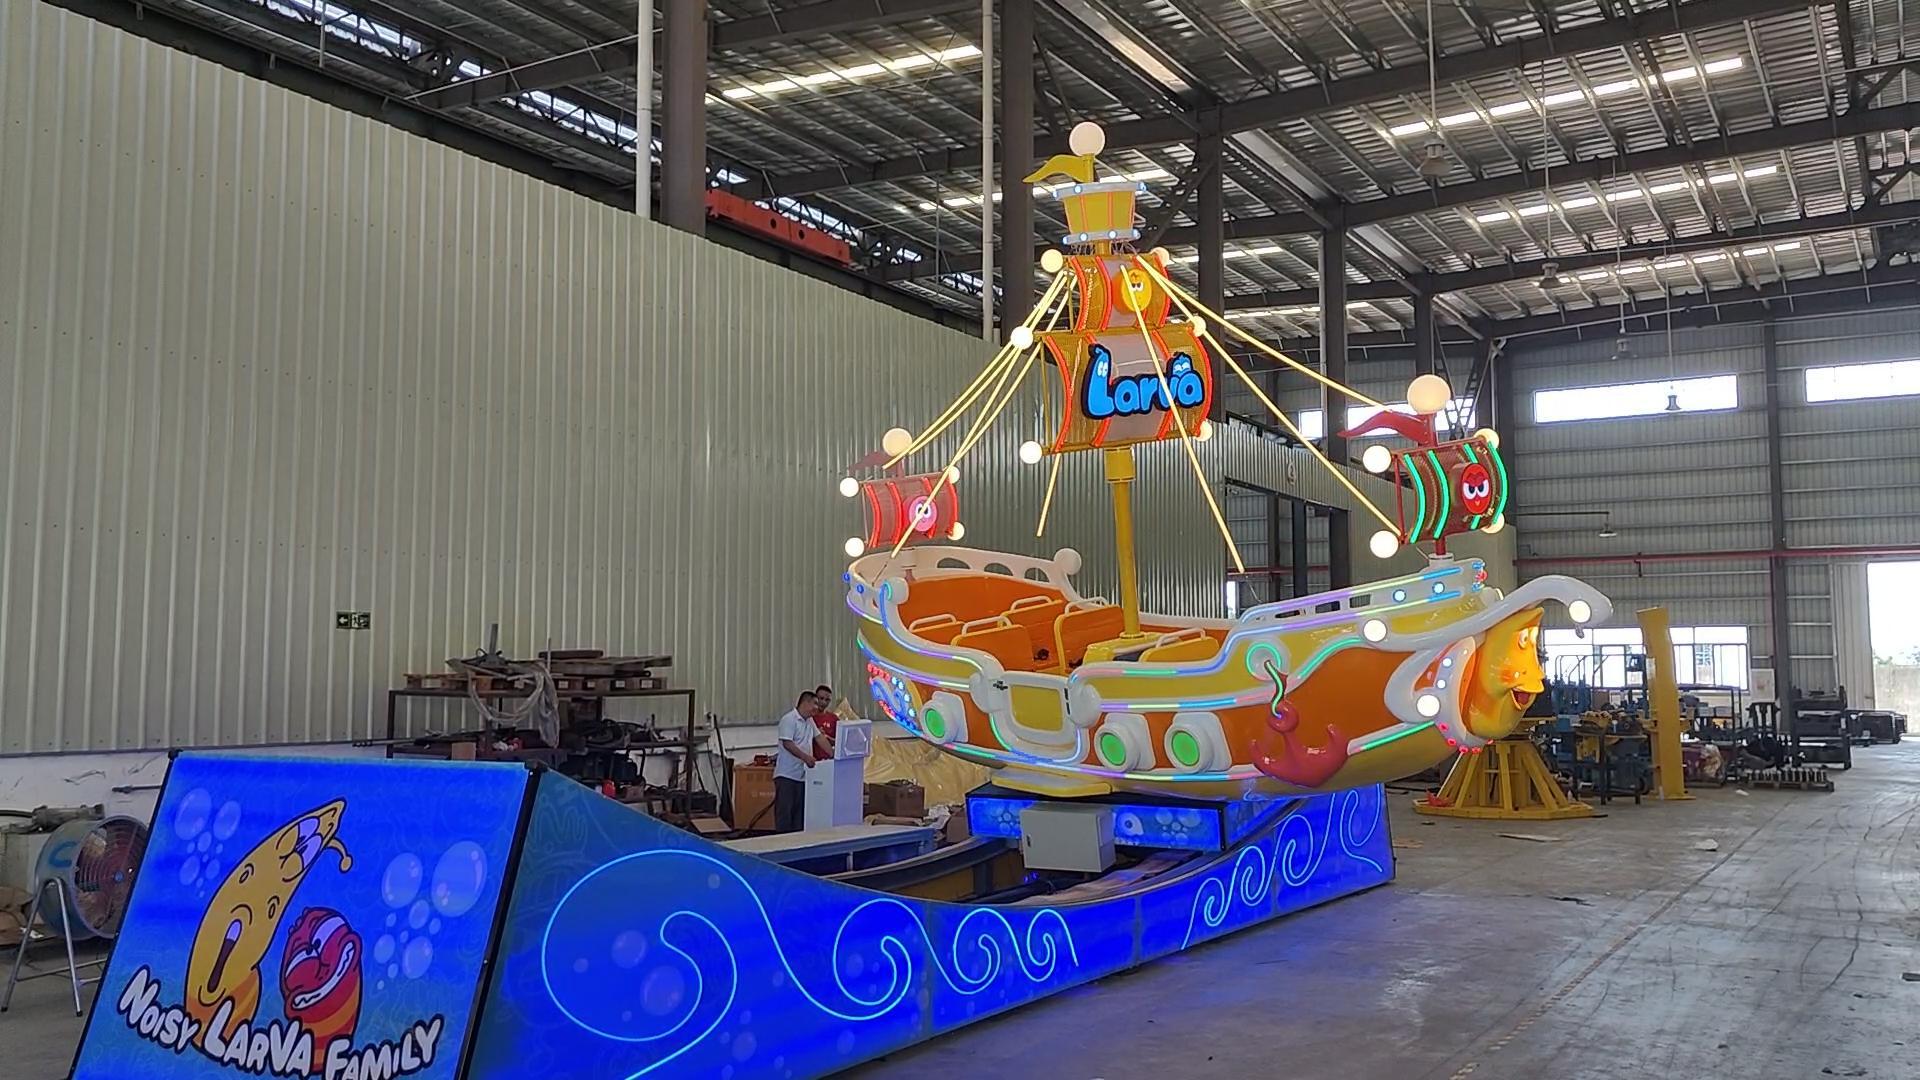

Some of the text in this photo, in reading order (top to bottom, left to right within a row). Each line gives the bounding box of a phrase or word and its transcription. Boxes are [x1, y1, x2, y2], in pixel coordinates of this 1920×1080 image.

[1085, 345, 1204, 418] Larva
[118, 966, 442, 1080] NOISY LARVA FAMILY
